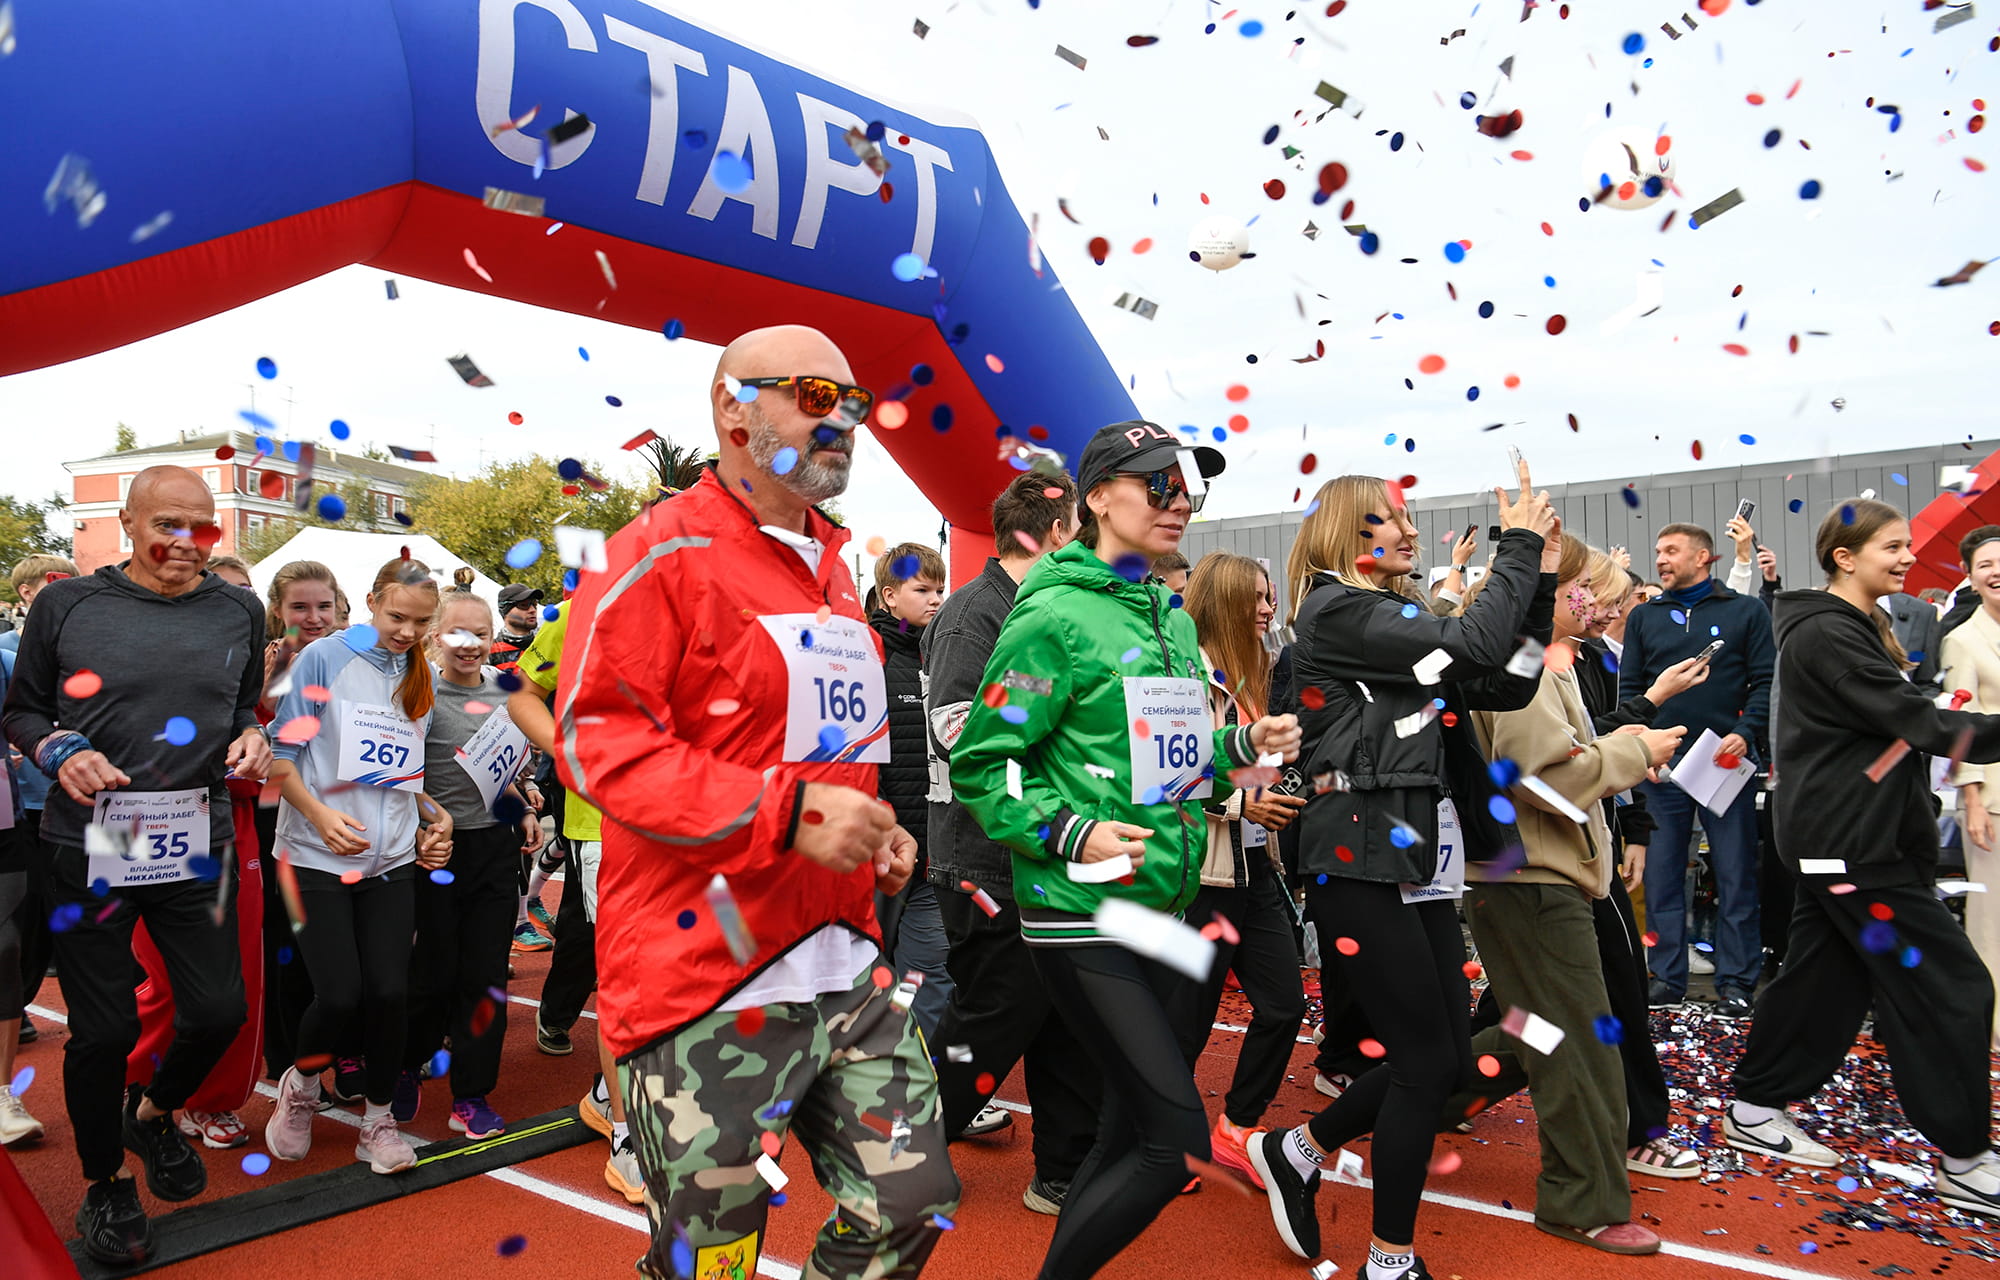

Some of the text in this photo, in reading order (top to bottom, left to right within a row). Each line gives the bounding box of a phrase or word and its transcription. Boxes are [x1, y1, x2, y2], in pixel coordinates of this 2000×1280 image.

[475, 0, 954, 281] СТАРТ
[813, 677, 866, 723] 166
[1142, 705, 1202, 716] СЕМЕЙНЫЙ ЗАБЕГ
[353, 720, 396, 733] СЕМЕЙНЫЙ
[360, 739, 410, 768] 267
[488, 744, 518, 784] 312
[1154, 734, 1198, 769] 168
[170, 810, 196, 819] ЗАБЕГ
[120, 832, 189, 861] 35
[124, 871, 180, 881] МИХАЙЛОВ
[130, 863, 177, 873] ВЛАДИМИР
[1294, 1128, 1325, 1164] HUGO
[1369, 1249, 1410, 1266] HUGO
